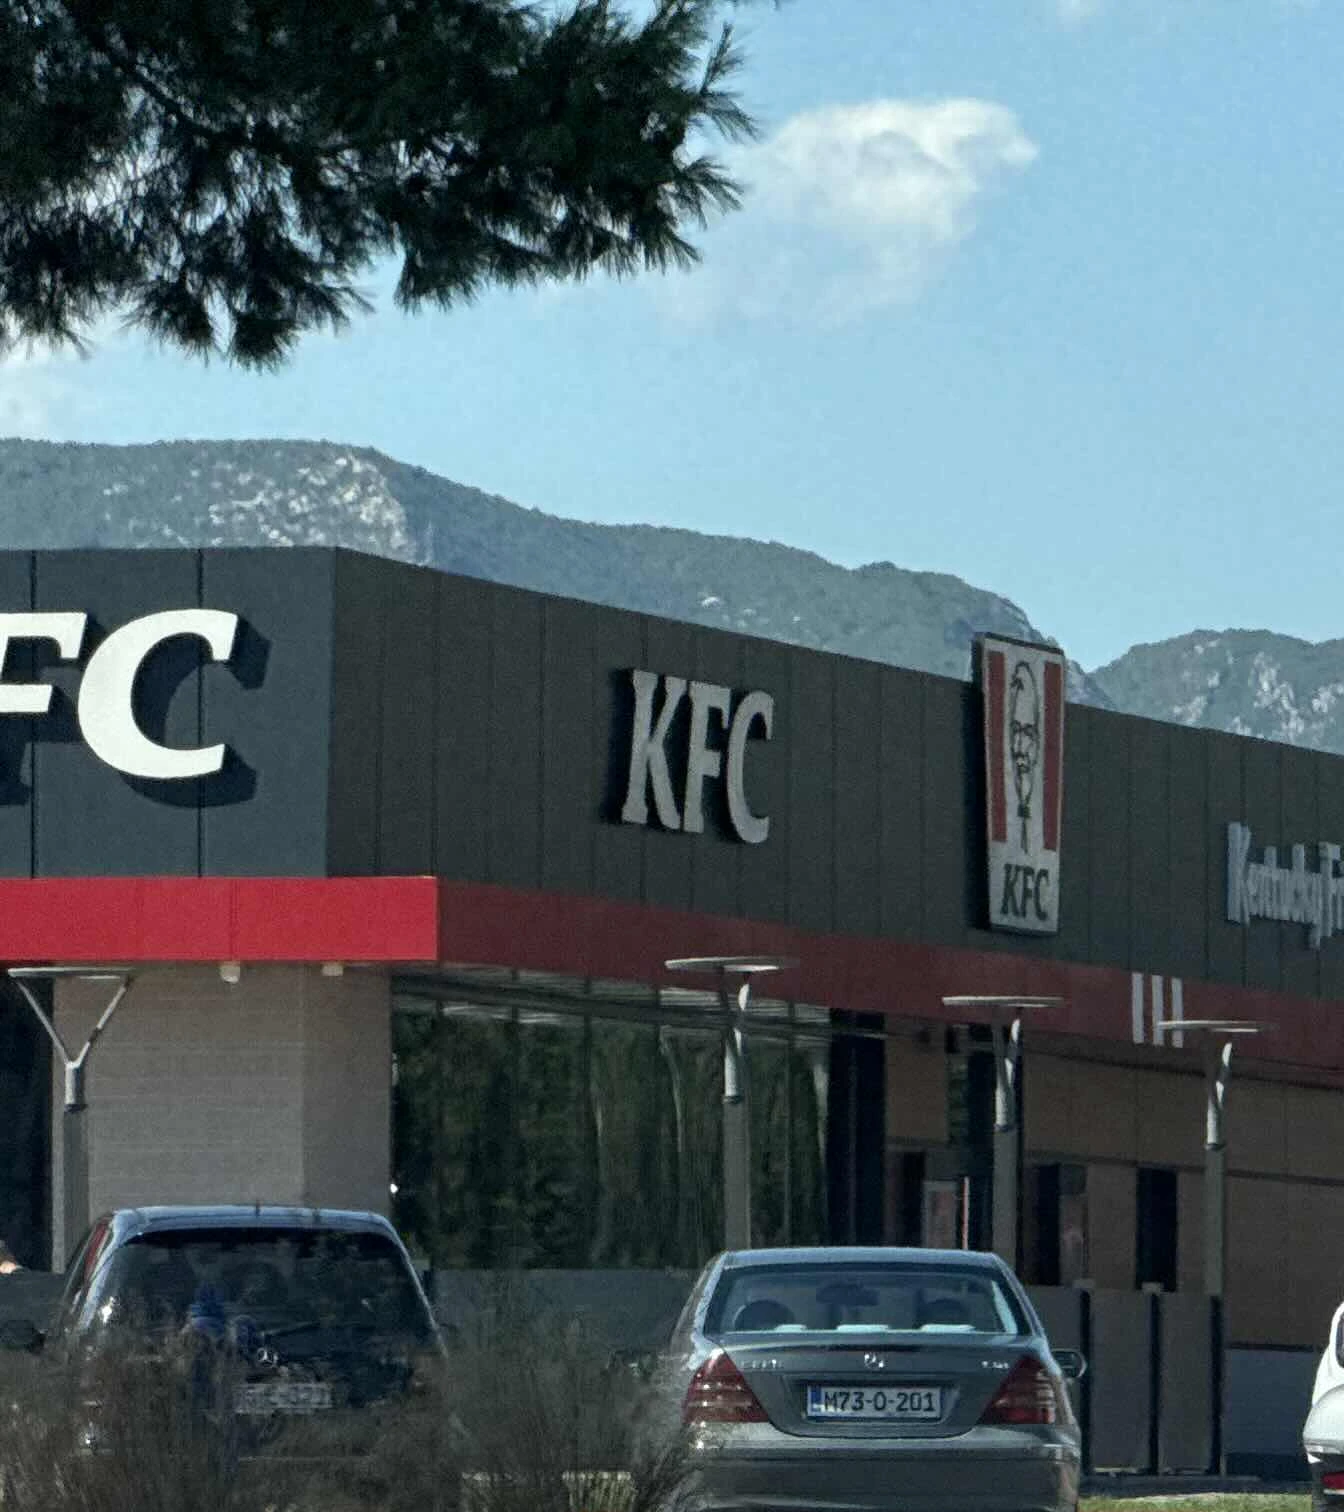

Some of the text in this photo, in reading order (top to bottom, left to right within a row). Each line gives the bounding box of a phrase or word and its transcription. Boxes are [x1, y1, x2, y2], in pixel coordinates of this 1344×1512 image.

[621, 669, 775, 844] KFC
[1000, 863, 1050, 922] KFC
[1227, 821, 1321, 950] Kentucky
